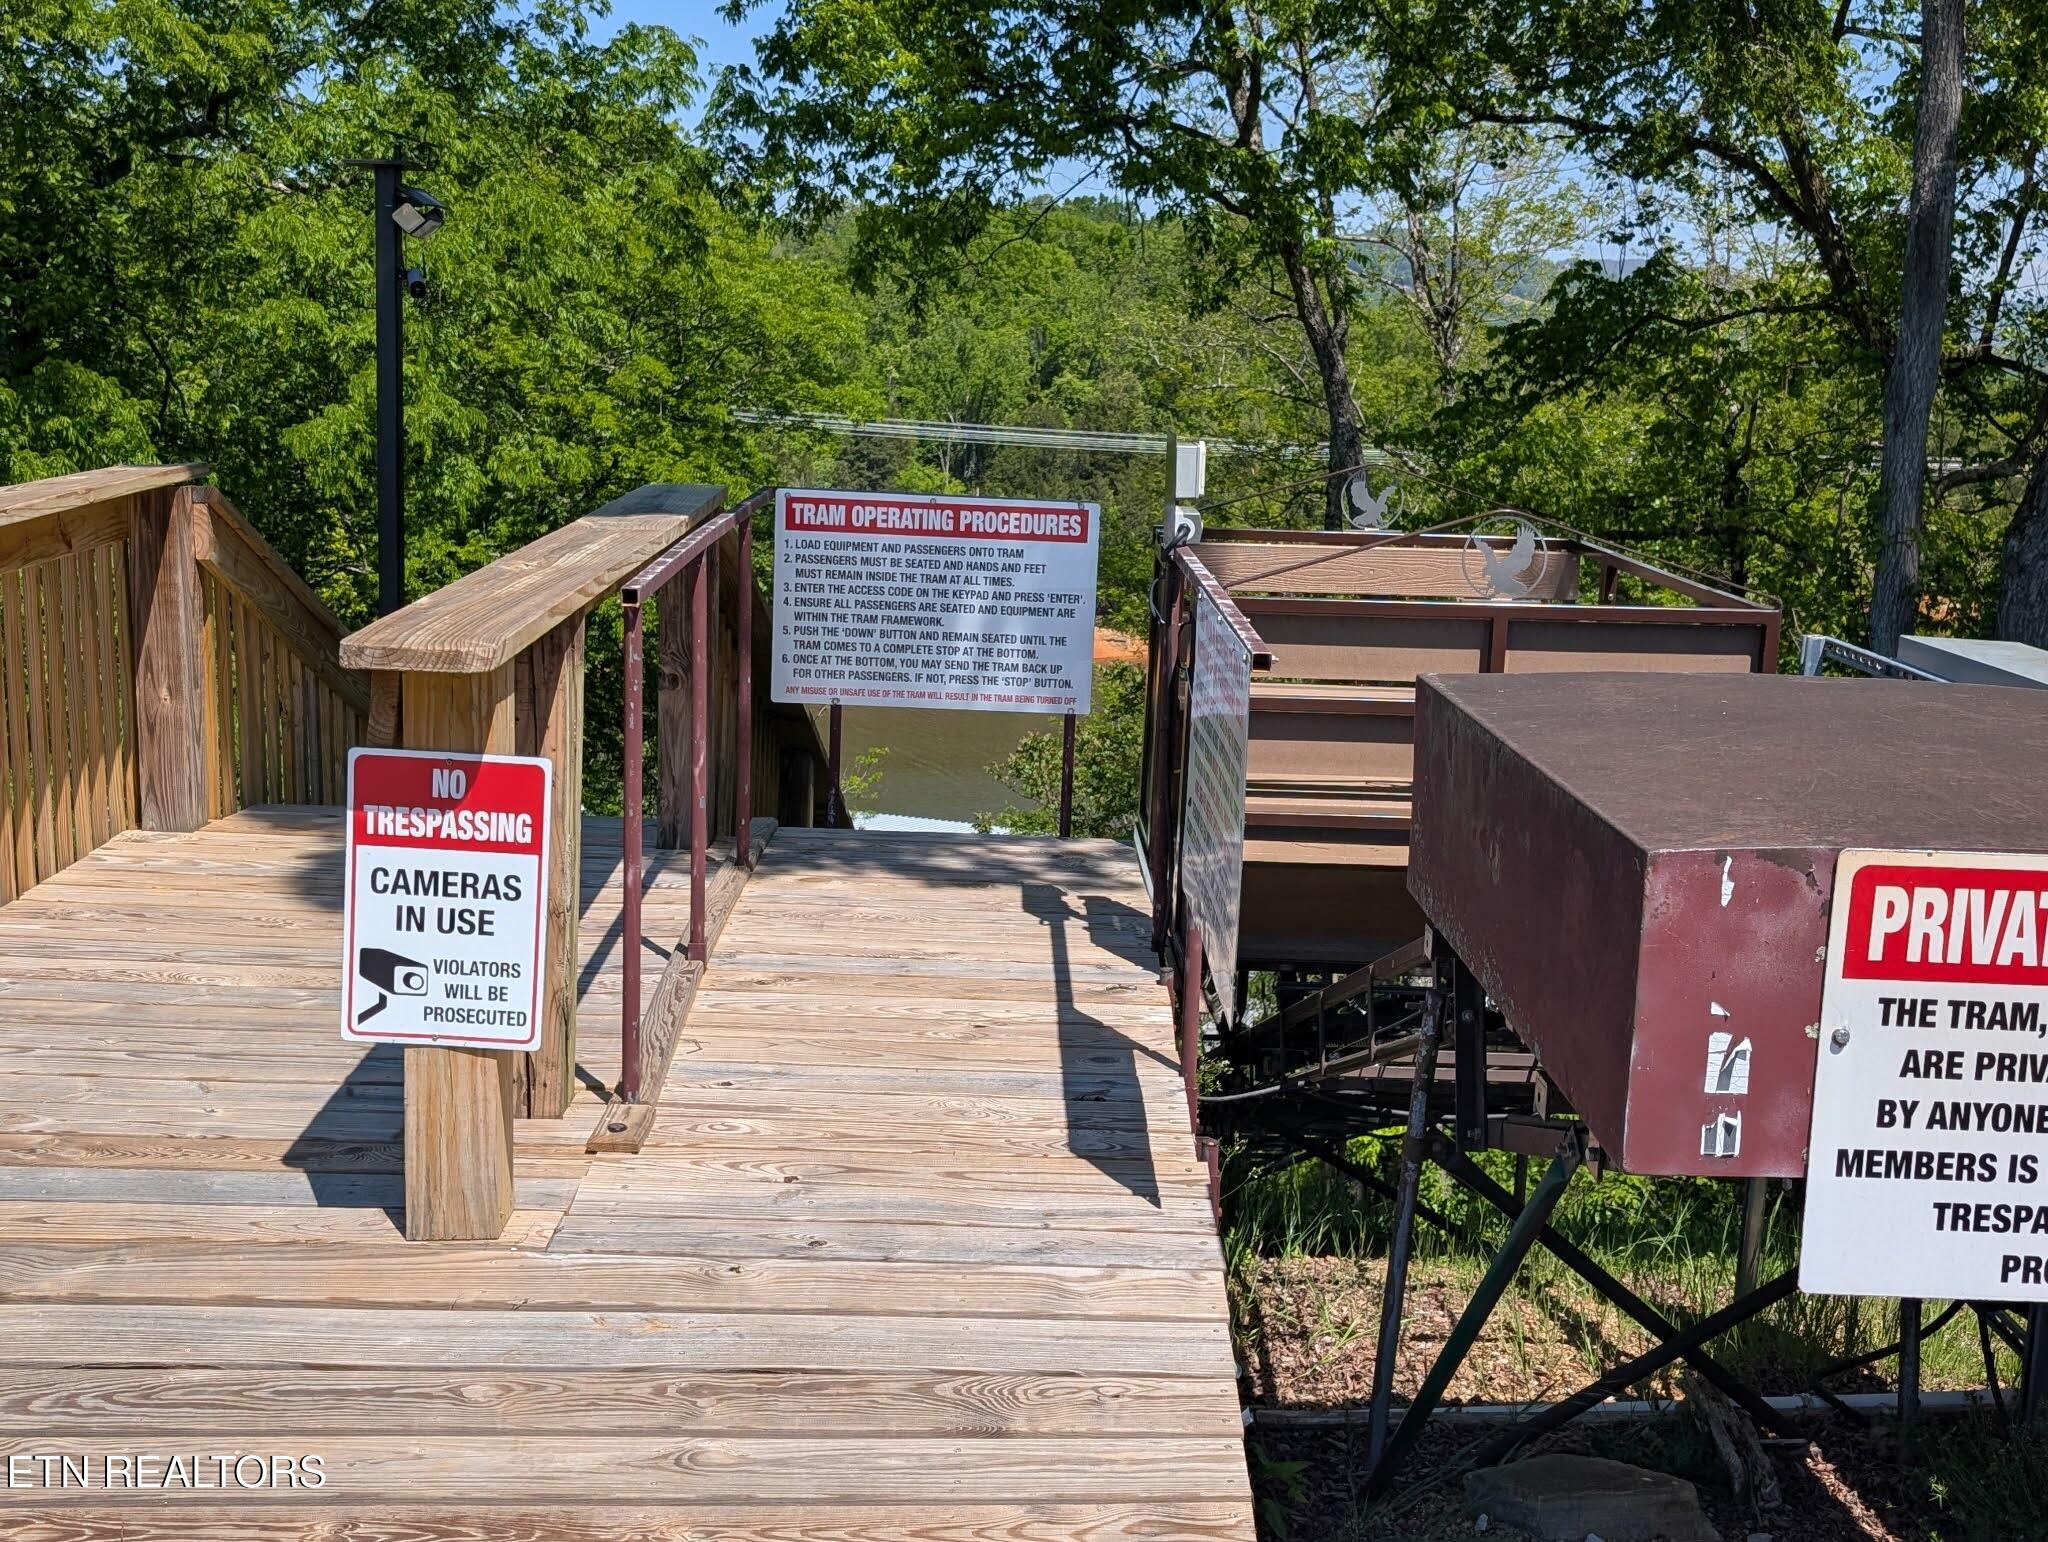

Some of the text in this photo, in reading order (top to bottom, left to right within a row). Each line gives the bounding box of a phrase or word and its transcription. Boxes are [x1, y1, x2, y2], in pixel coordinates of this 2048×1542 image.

[792, 501, 1081, 537] TRAM OPERATING PROCEDURES
[784, 538, 1024, 559] 1. LOAD EQUIPMENT AND PASSENGERS ONTO TRAM
[783, 553, 1046, 574] 2. PASSENGERS MUST BE SEATED AND HANDS AND FEET
[795, 568, 1014, 587] MUST REMAIN INSIDE THE TRAM AT ALL TIMES.
[783, 582, 791, 592] 3.
[794, 582, 824, 593] ENTER
[828, 584, 845, 594] THE
[847, 584, 885, 596] ACCESS
[888, 586, 913, 597] CODE
[916, 587, 929, 597] ON
[932, 588, 949, 598] THE
[952, 589, 989, 600] KEYPAD
[991, 591, 1011, 601] AND
[1014, 592, 1044, 602] PRESS
[783, 596, 1075, 618] 4. ENSURE ALL PASSENGERS ARE SEATED AND EQUIPMENT ARE
[793, 611, 944, 627] WITHIN THE TRAM FRAMEWORK.
[782, 625, 790, 635] 5.
[793, 625, 818, 636] PUSH
[821, 626, 839, 637] THE
[879, 629, 916, 640] BUTTON
[918, 630, 939, 641] AND
[942, 631, 978, 642] REMAIN
[981, 633, 1017, 644] SEATED
[1020, 634, 1047, 645] UNTIL
[1048, 636, 1067, 646] THE
[793, 639, 1038, 659] TRAM COMES TO A COMPLETE STOP AT THE BOTTOM.
[782, 653, 1062, 674] 6. ONCE AT THE BOTTOM, YOU MAY SEND THE TRAM BACK UP
[793, 668, 811, 678] FOR
[814, 669, 845, 679] OTHER
[848, 670, 912, 682] PASSENGERS.
[914, 673, 923, 682] IF
[926, 673, 946, 685] NOT,
[949, 674, 979, 685] PRESS
[981, 675, 998, 685] THE
[1034, 677, 1073, 688] BUTTON.
[786, 686, 1076, 705] ANY MISUSE OR UNSAFE USE OF THE TRAM WILL RESULT IN THE TRAM BEING TURNED OFF
[432, 768, 466, 800] NO
[364, 805, 532, 844] TRESPASSING
[370, 867, 522, 901] CAMERAS
[396, 905, 495, 936] IN USE
[1868, 885, 2048, 967] PRIVA
[434, 959, 521, 978] VIOLATORS
[444, 984, 508, 1002] WILL BE
[424, 1006, 526, 1026] PROSECUTED
[1879, 998, 2046, 1038] THE TRAM,
[1899, 1050, 2048, 1083] ARE PRIV
[1877, 1100, 2048, 1133] BY ANYONE
[1836, 1149, 2038, 1184] MEMBERS IS
[1934, 1203, 2048, 1234] TRESPA
[2000, 1255, 2048, 1284] PR
